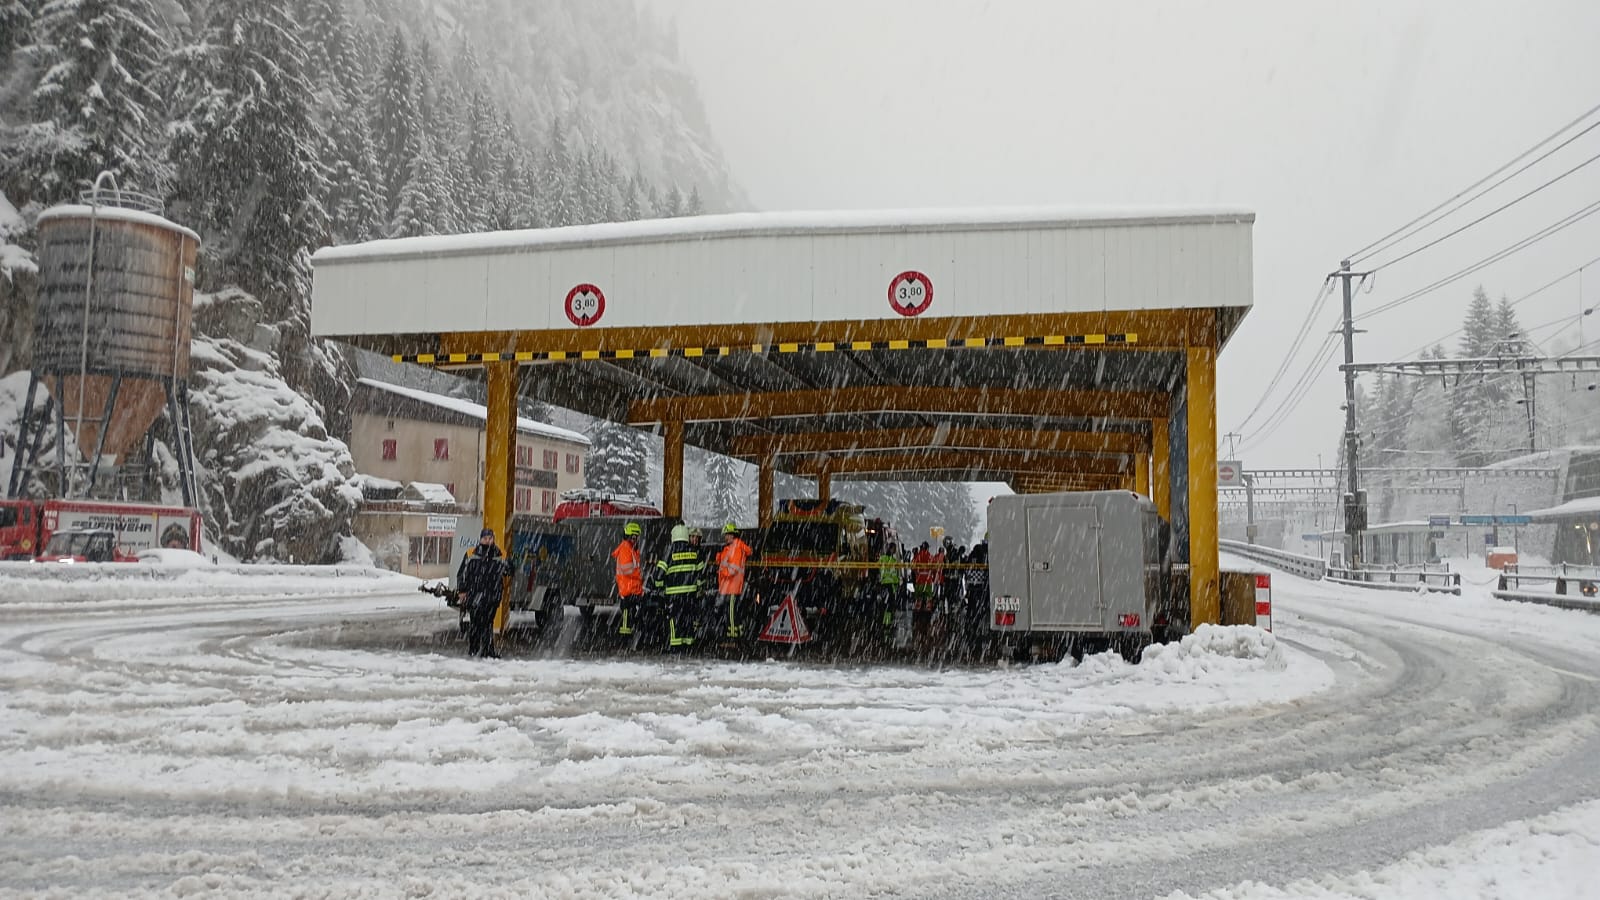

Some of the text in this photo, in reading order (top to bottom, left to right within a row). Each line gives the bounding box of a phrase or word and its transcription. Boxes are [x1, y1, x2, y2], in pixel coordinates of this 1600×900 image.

[899, 286, 922, 299] 3.80
[88, 515, 141, 523] FREIWILLIGE
[71, 520, 152, 533] FEUERWEHR
